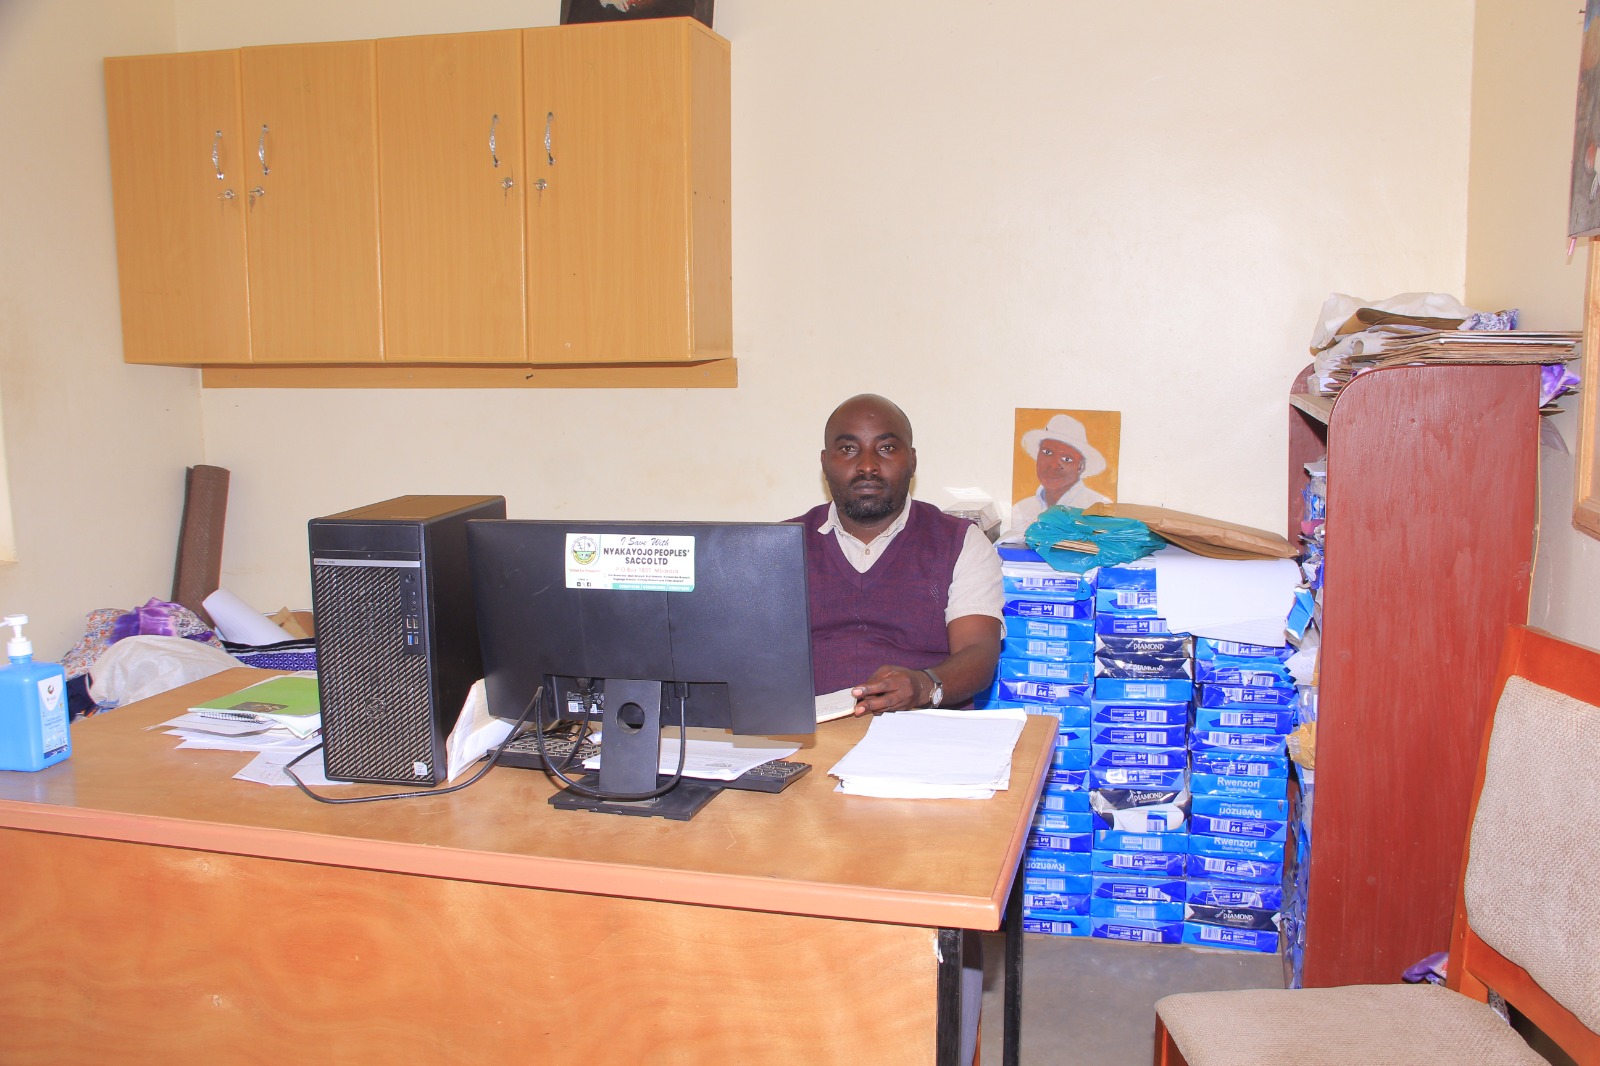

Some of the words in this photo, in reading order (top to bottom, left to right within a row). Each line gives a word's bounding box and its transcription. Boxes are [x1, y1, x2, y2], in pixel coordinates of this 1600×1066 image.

[620, 536, 626, 546] I
[628, 536, 648, 546] Save
[650, 537, 670, 547] With
[603, 547, 653, 556] NYAKAYOJO
[654, 548, 690, 557] PEOPLES'
[625, 556, 653, 565] SACCO
[653, 557, 668, 565] LTD
[1133, 642, 1165, 651] DIAMOND
[1217, 777, 1260, 788] Rwenzori
[1133, 791, 1163, 801] DIAMOND
[1219, 807, 1262, 819] Rwenzori
[1213, 837, 1257, 848] Rwenzori
[1026, 862, 1066, 872] Rwenzor
[1223, 911, 1254, 920] DIAMOND
